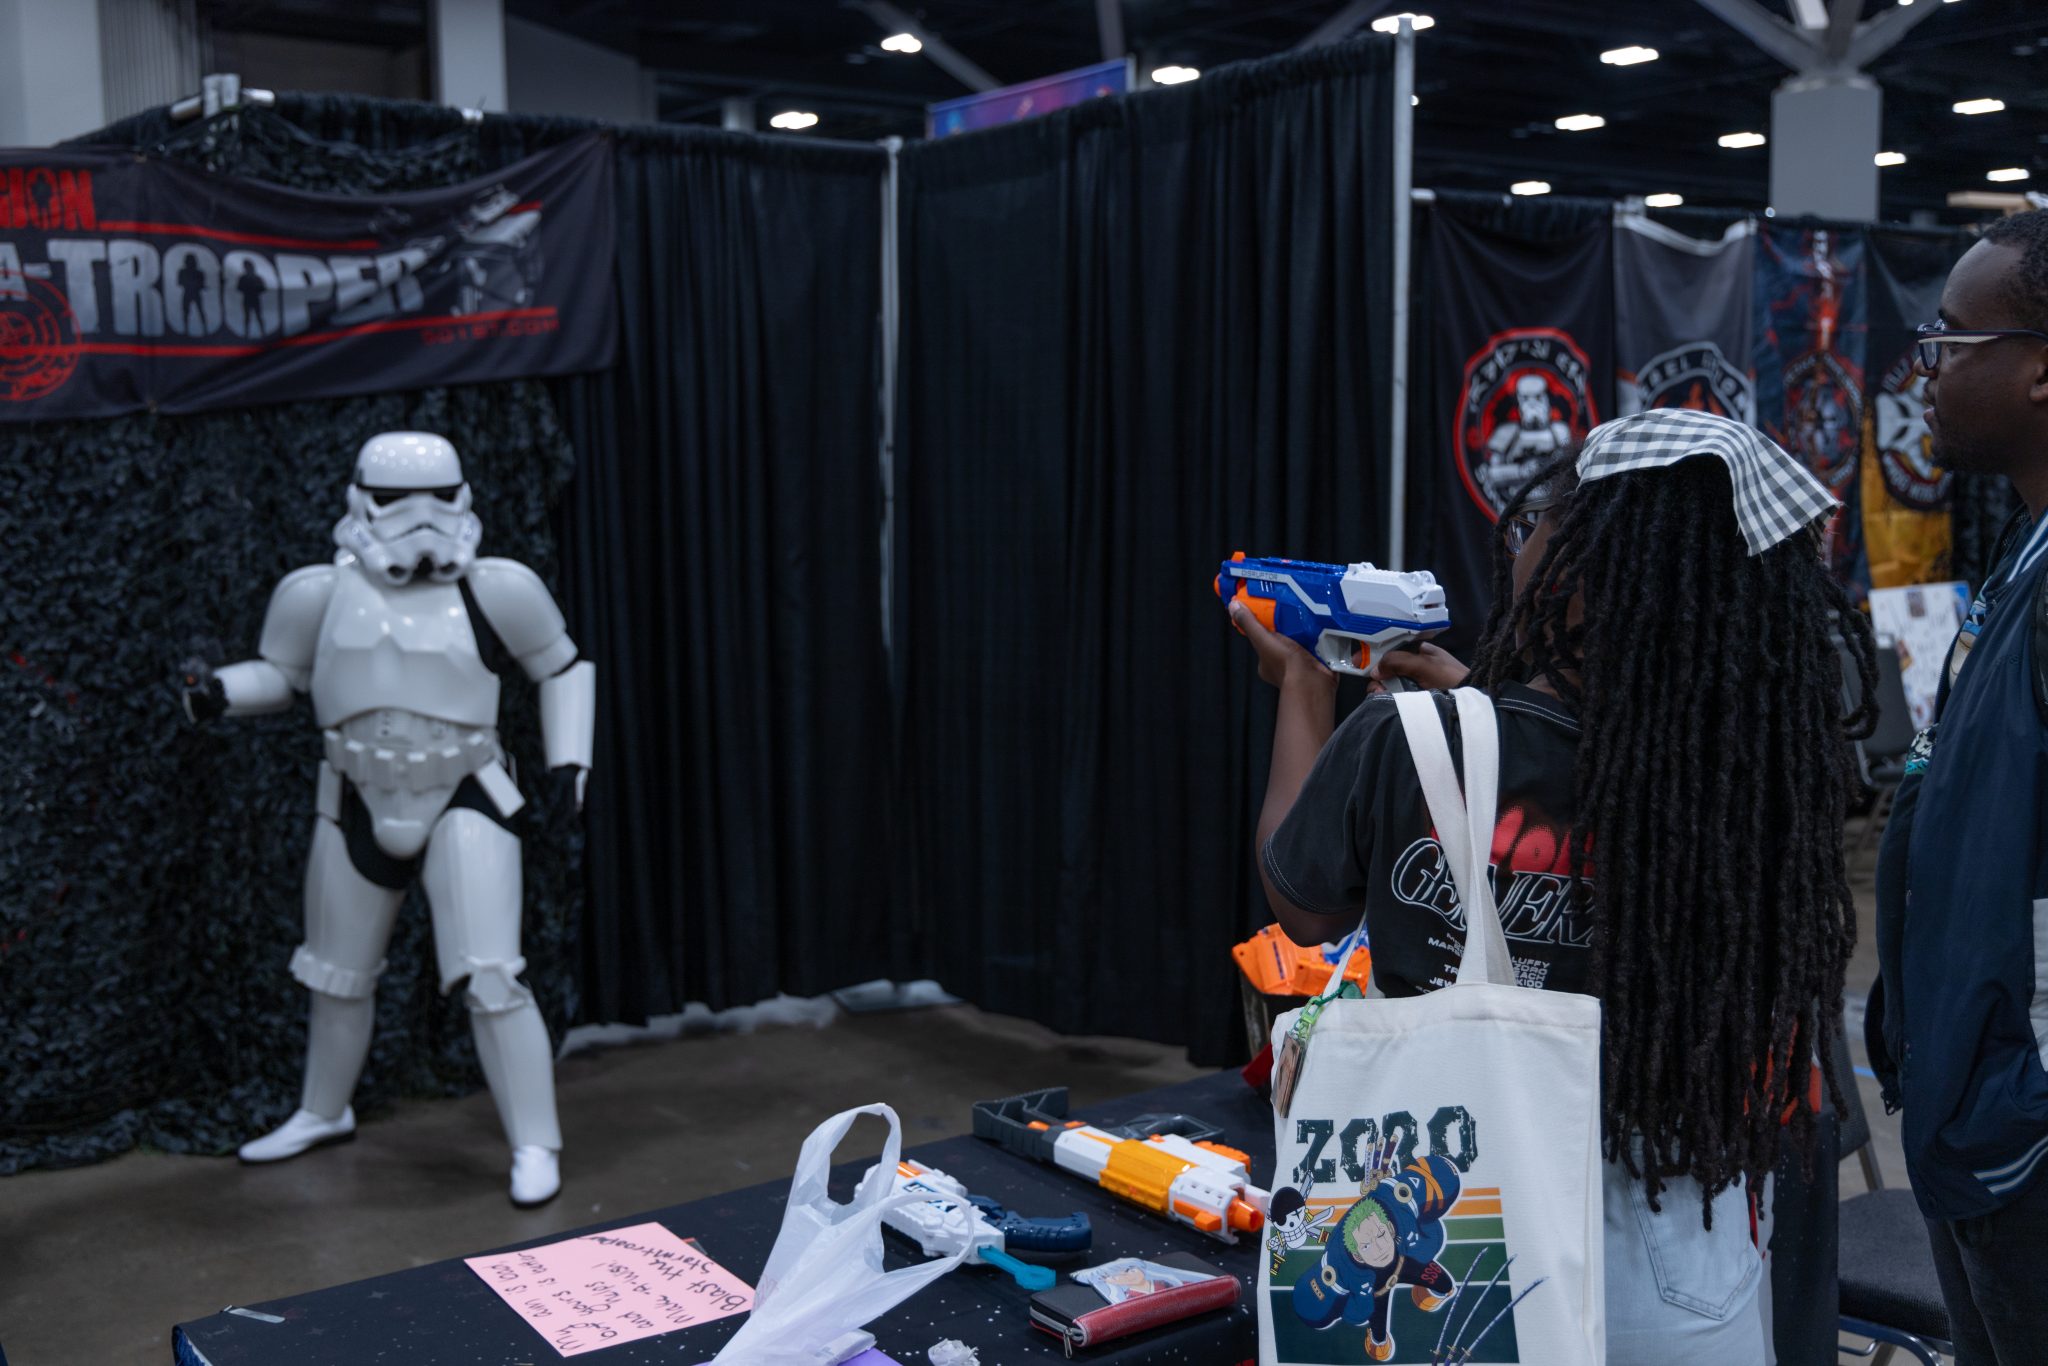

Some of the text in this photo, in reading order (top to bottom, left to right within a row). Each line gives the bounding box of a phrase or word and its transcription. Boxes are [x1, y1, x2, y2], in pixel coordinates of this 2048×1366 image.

[1515, 970, 1546, 982] EACH
[1293, 1105, 1479, 1183] ZORO
[504, 1283, 528, 1294] is
[536, 1276, 557, 1288] is
[648, 1258, 747, 1311] Blast the
[524, 1298, 552, 1318] aim
[616, 1311, 654, 1329] and
[555, 1322, 589, 1350] My
